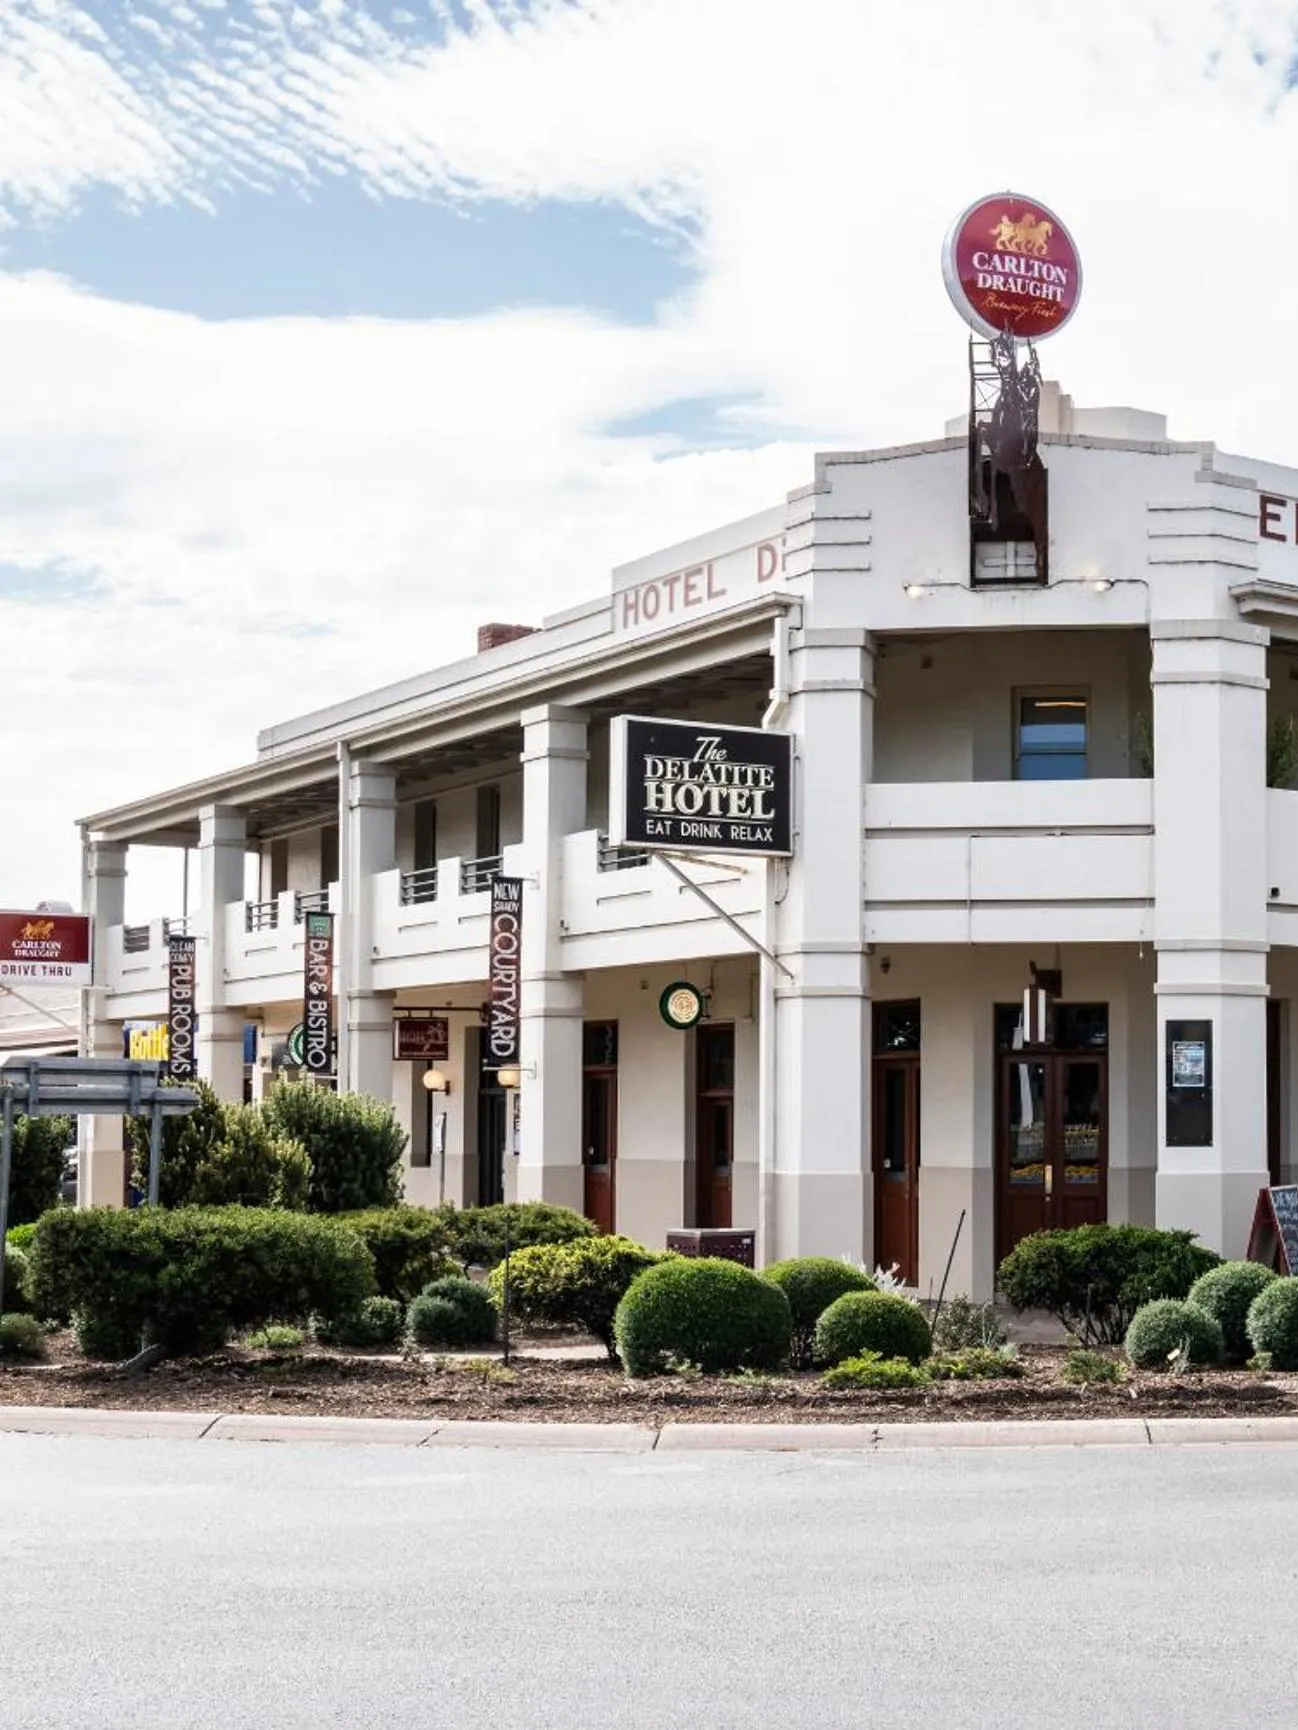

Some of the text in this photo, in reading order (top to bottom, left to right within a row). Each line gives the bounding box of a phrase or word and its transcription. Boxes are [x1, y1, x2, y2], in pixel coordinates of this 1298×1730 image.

[972, 252, 1067, 285] CARLTON
[977, 273, 1064, 302] DRAUGHT
[623, 563, 727, 629] HOTEL
[693, 736, 727, 762] The
[644, 758, 774, 788] DELATITE
[643, 782, 775, 819] HOTEL
[646, 819, 773, 842] EAT DRINK RELAX
[494, 882, 520, 900] NEW
[1, 965, 72, 976] DRIVE THRU
[309, 938, 329, 977] BAR
[309, 981, 328, 996] &
[492, 914, 517, 1057] COURTYARD
[171, 965, 192, 1073] PUB ROOMS
[307, 1000, 327, 1068] BISTRO
